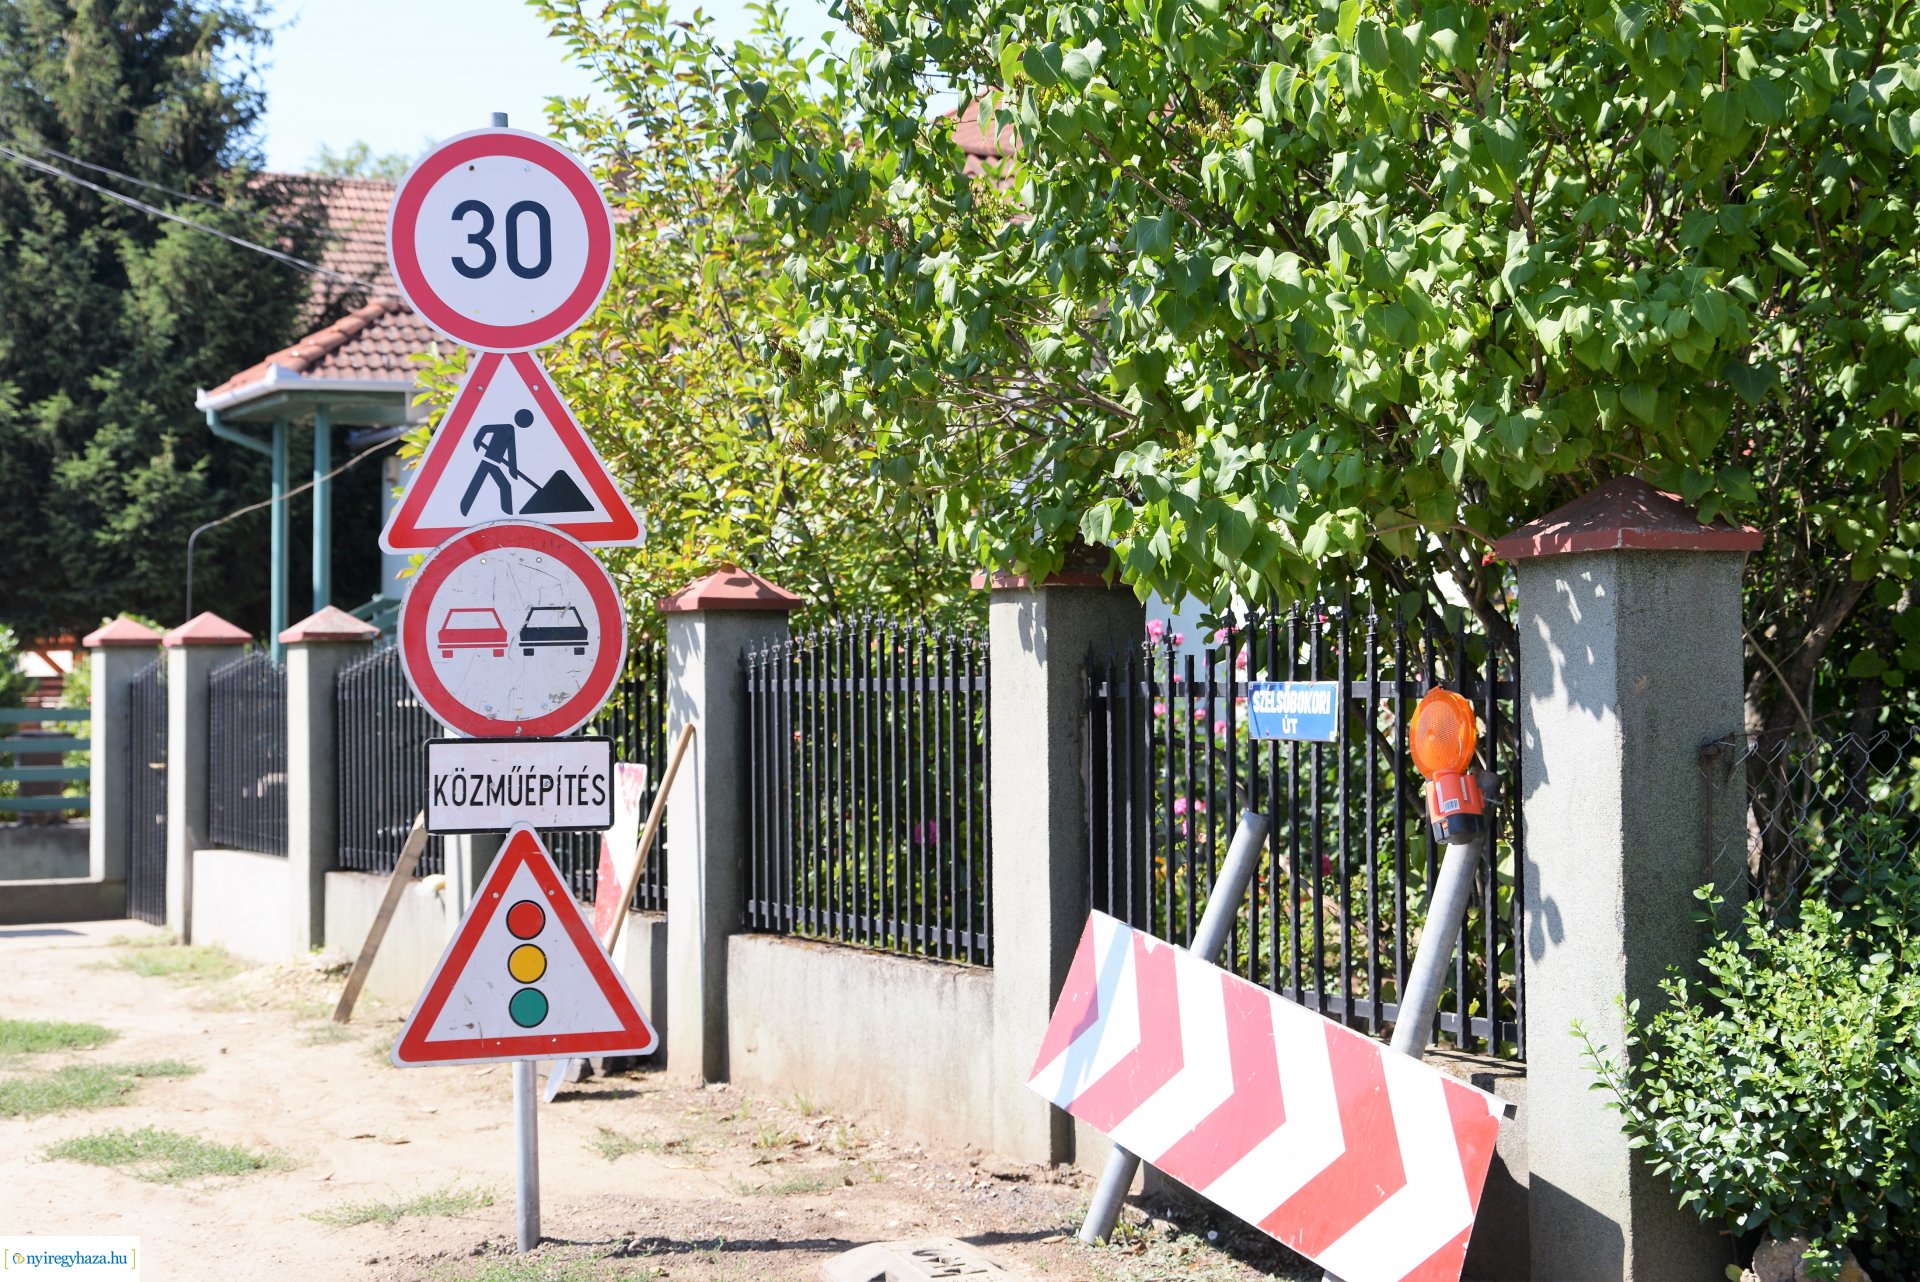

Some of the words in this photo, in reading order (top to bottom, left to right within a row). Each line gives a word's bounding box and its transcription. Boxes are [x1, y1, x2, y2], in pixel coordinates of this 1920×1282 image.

[451, 199, 552, 279] 30
[1282, 714, 1298, 734] ÚT
[433, 765, 606, 807] KÖZMŰÉPÍTÉS
